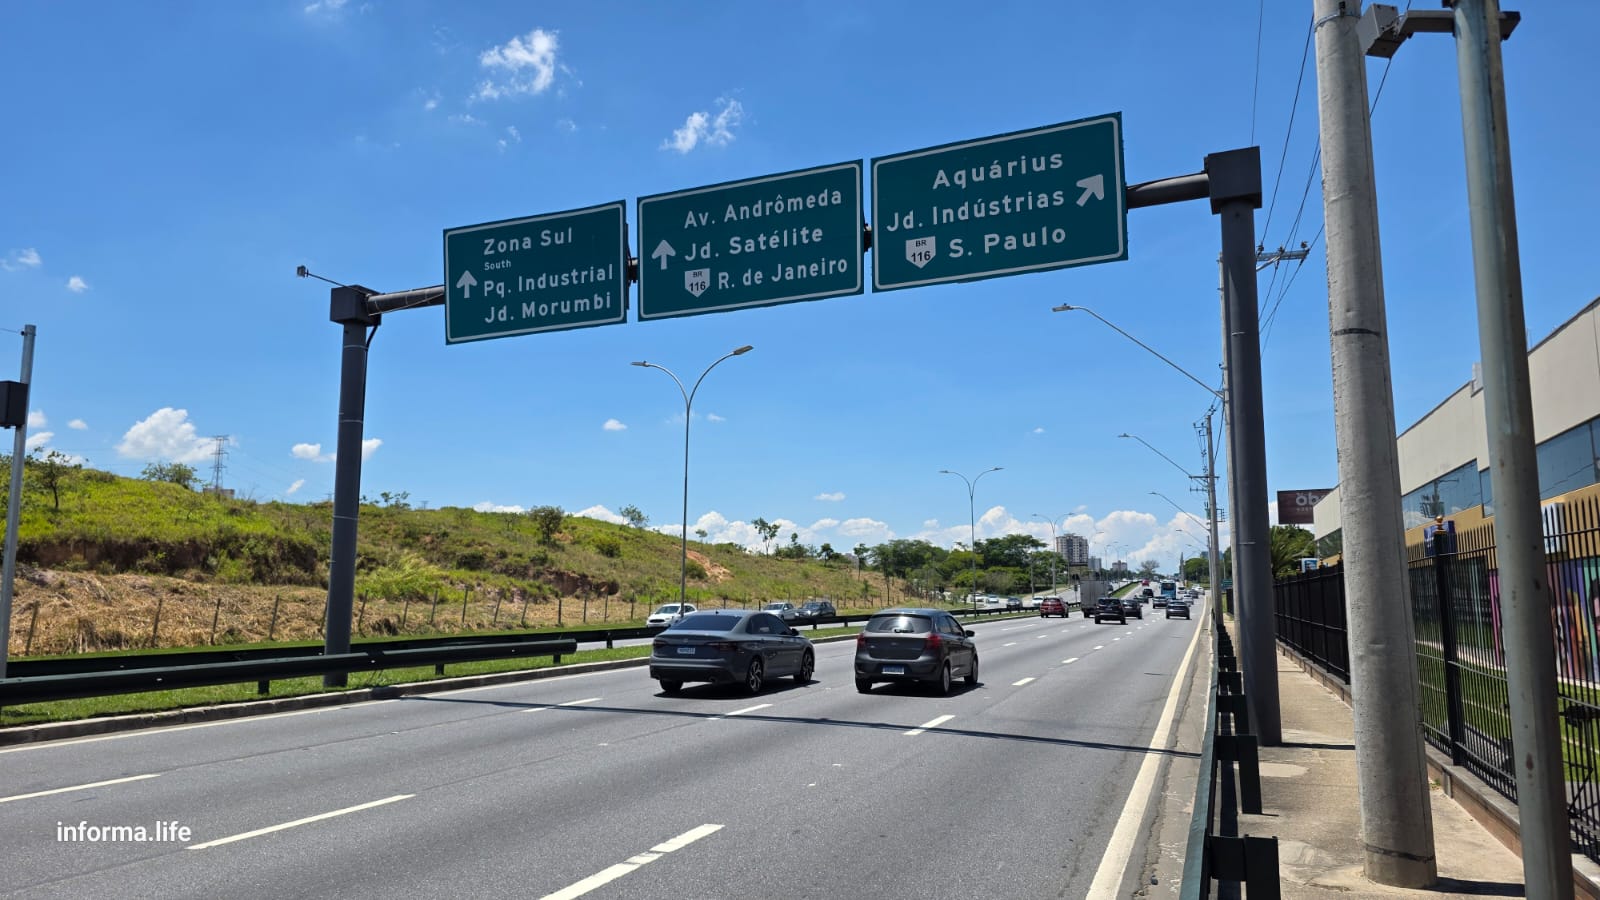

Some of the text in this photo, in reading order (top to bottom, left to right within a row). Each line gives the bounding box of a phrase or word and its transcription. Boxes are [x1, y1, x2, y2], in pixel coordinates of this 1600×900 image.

[932, 153, 1064, 190] Aquárius
[684, 189, 842, 229] Av. Andrômeda
[886, 190, 1065, 232] Jd. Indústrias
[483, 227, 573, 256] Zona Sul
[684, 226, 824, 262] Jd. Satélite
[910, 251, 931, 263] 116
[915, 239, 927, 248] BR
[949, 226, 1066, 258] S. Paulo
[483, 263, 613, 298] Pq. Industrial
[484, 259, 512, 271] South
[692, 270, 703, 278] BR
[718, 257, 848, 290] R. de Janeiro
[689, 281, 706, 292] 116
[484, 291, 611, 324] Jd. Morumbi
